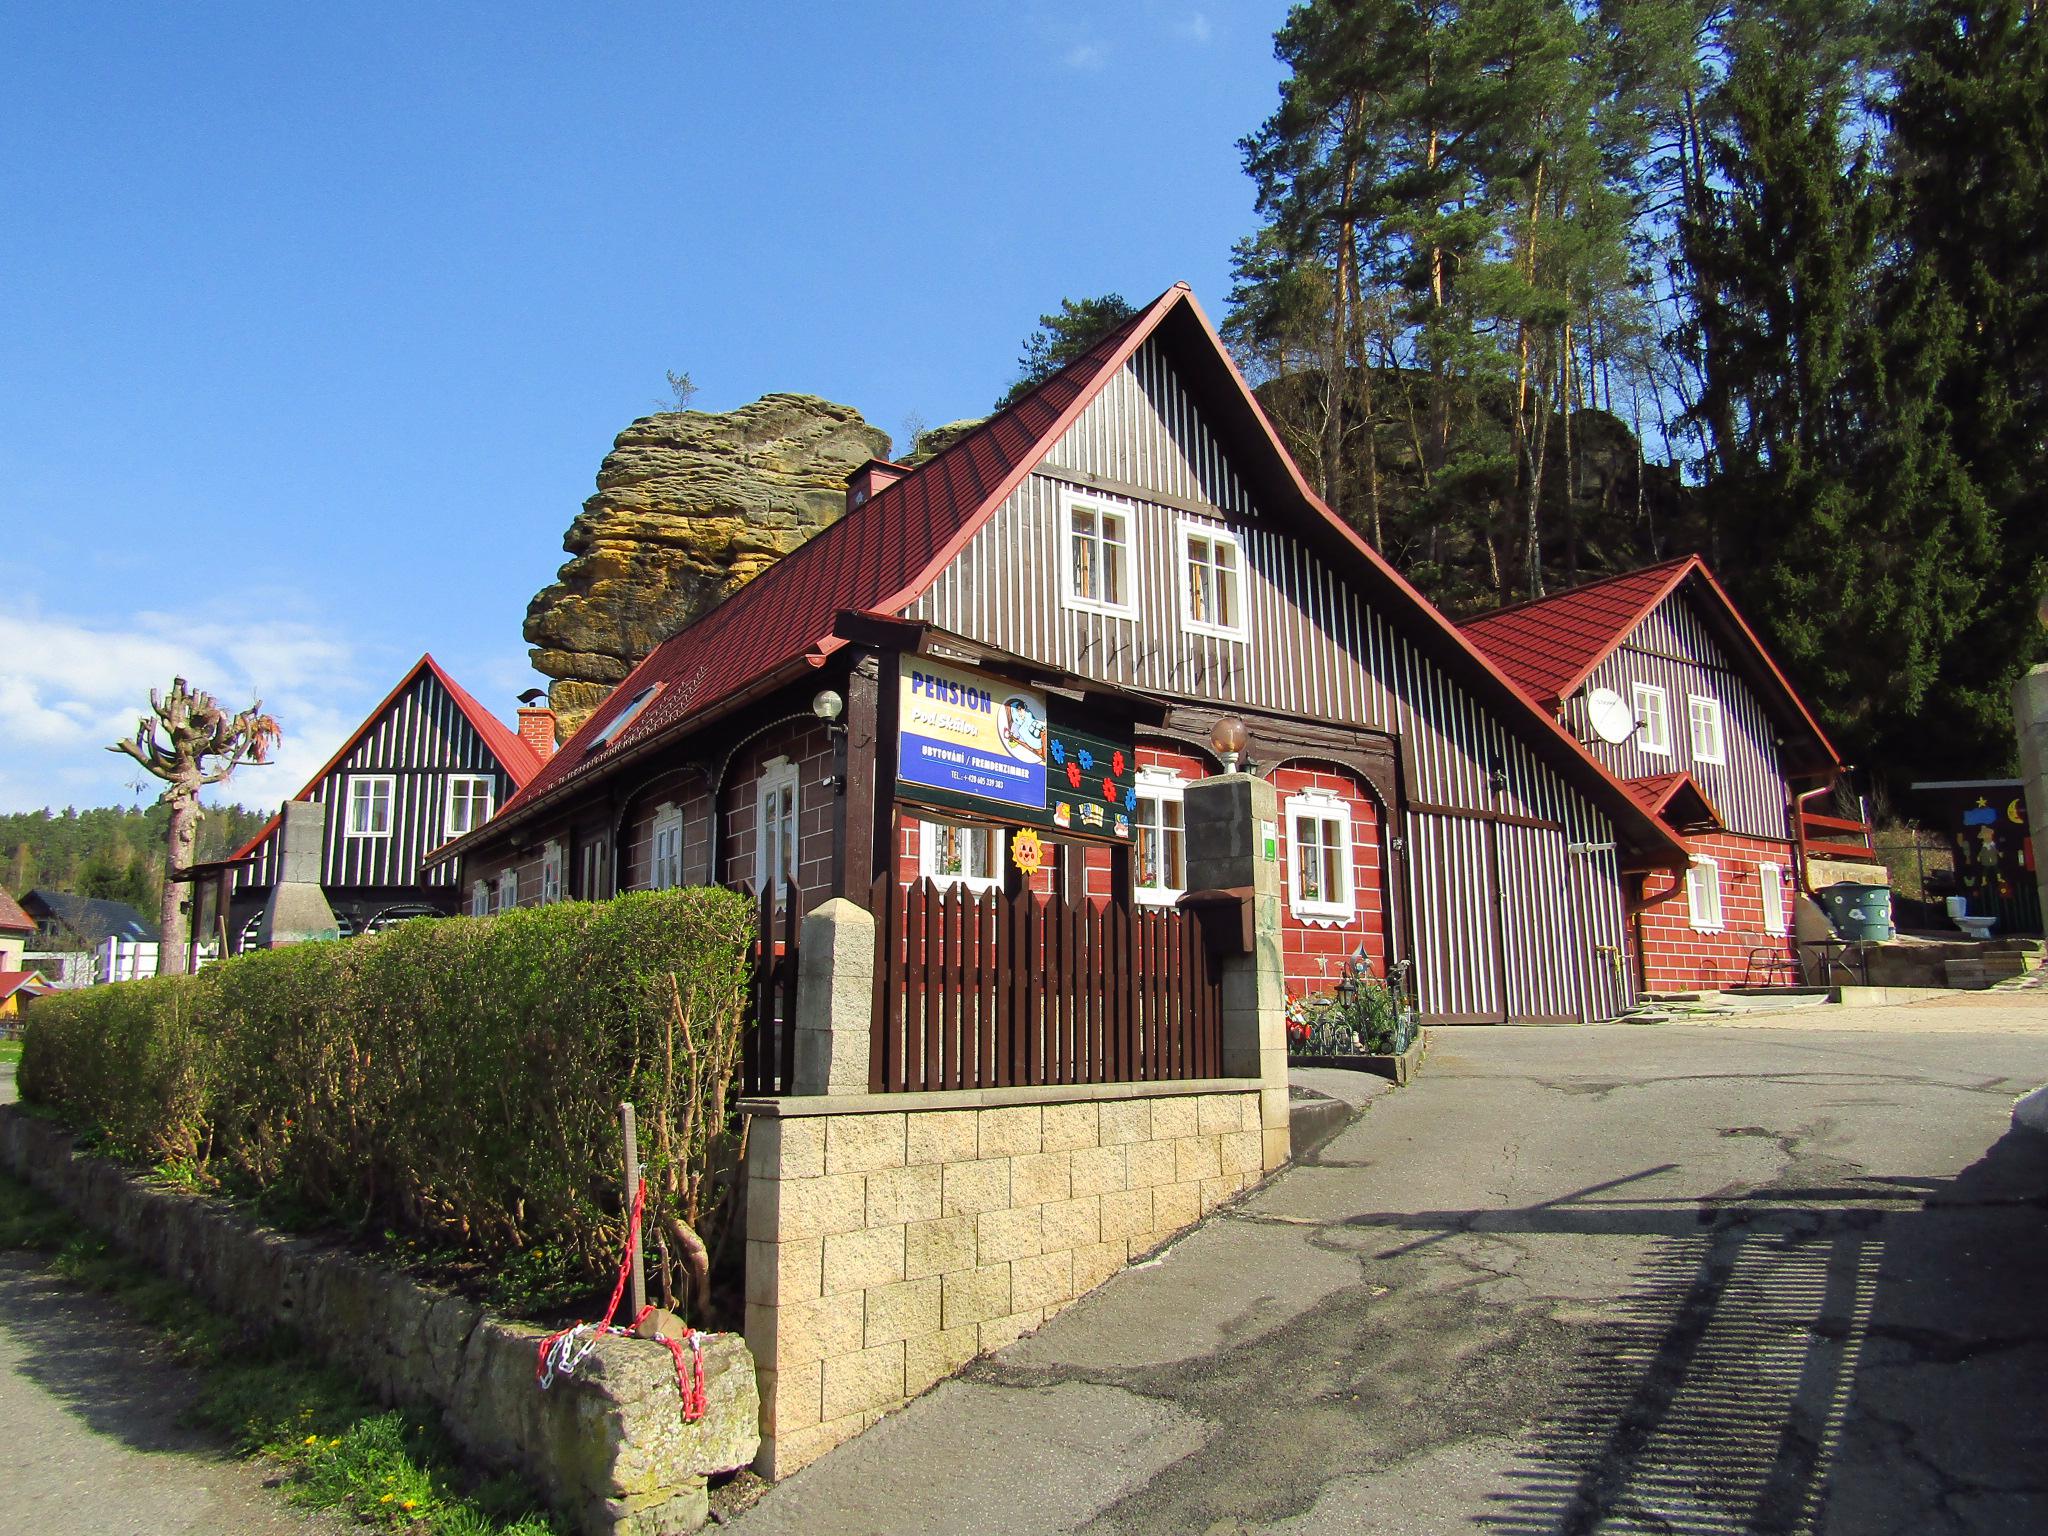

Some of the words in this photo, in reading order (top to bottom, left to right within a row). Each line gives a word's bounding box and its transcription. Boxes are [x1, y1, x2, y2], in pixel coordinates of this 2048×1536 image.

[912, 671, 991, 714] PENSION
[922, 745, 965, 763] UBYTOVÁNÍ
[971, 757, 1030, 779] FREMDENZIMMER
